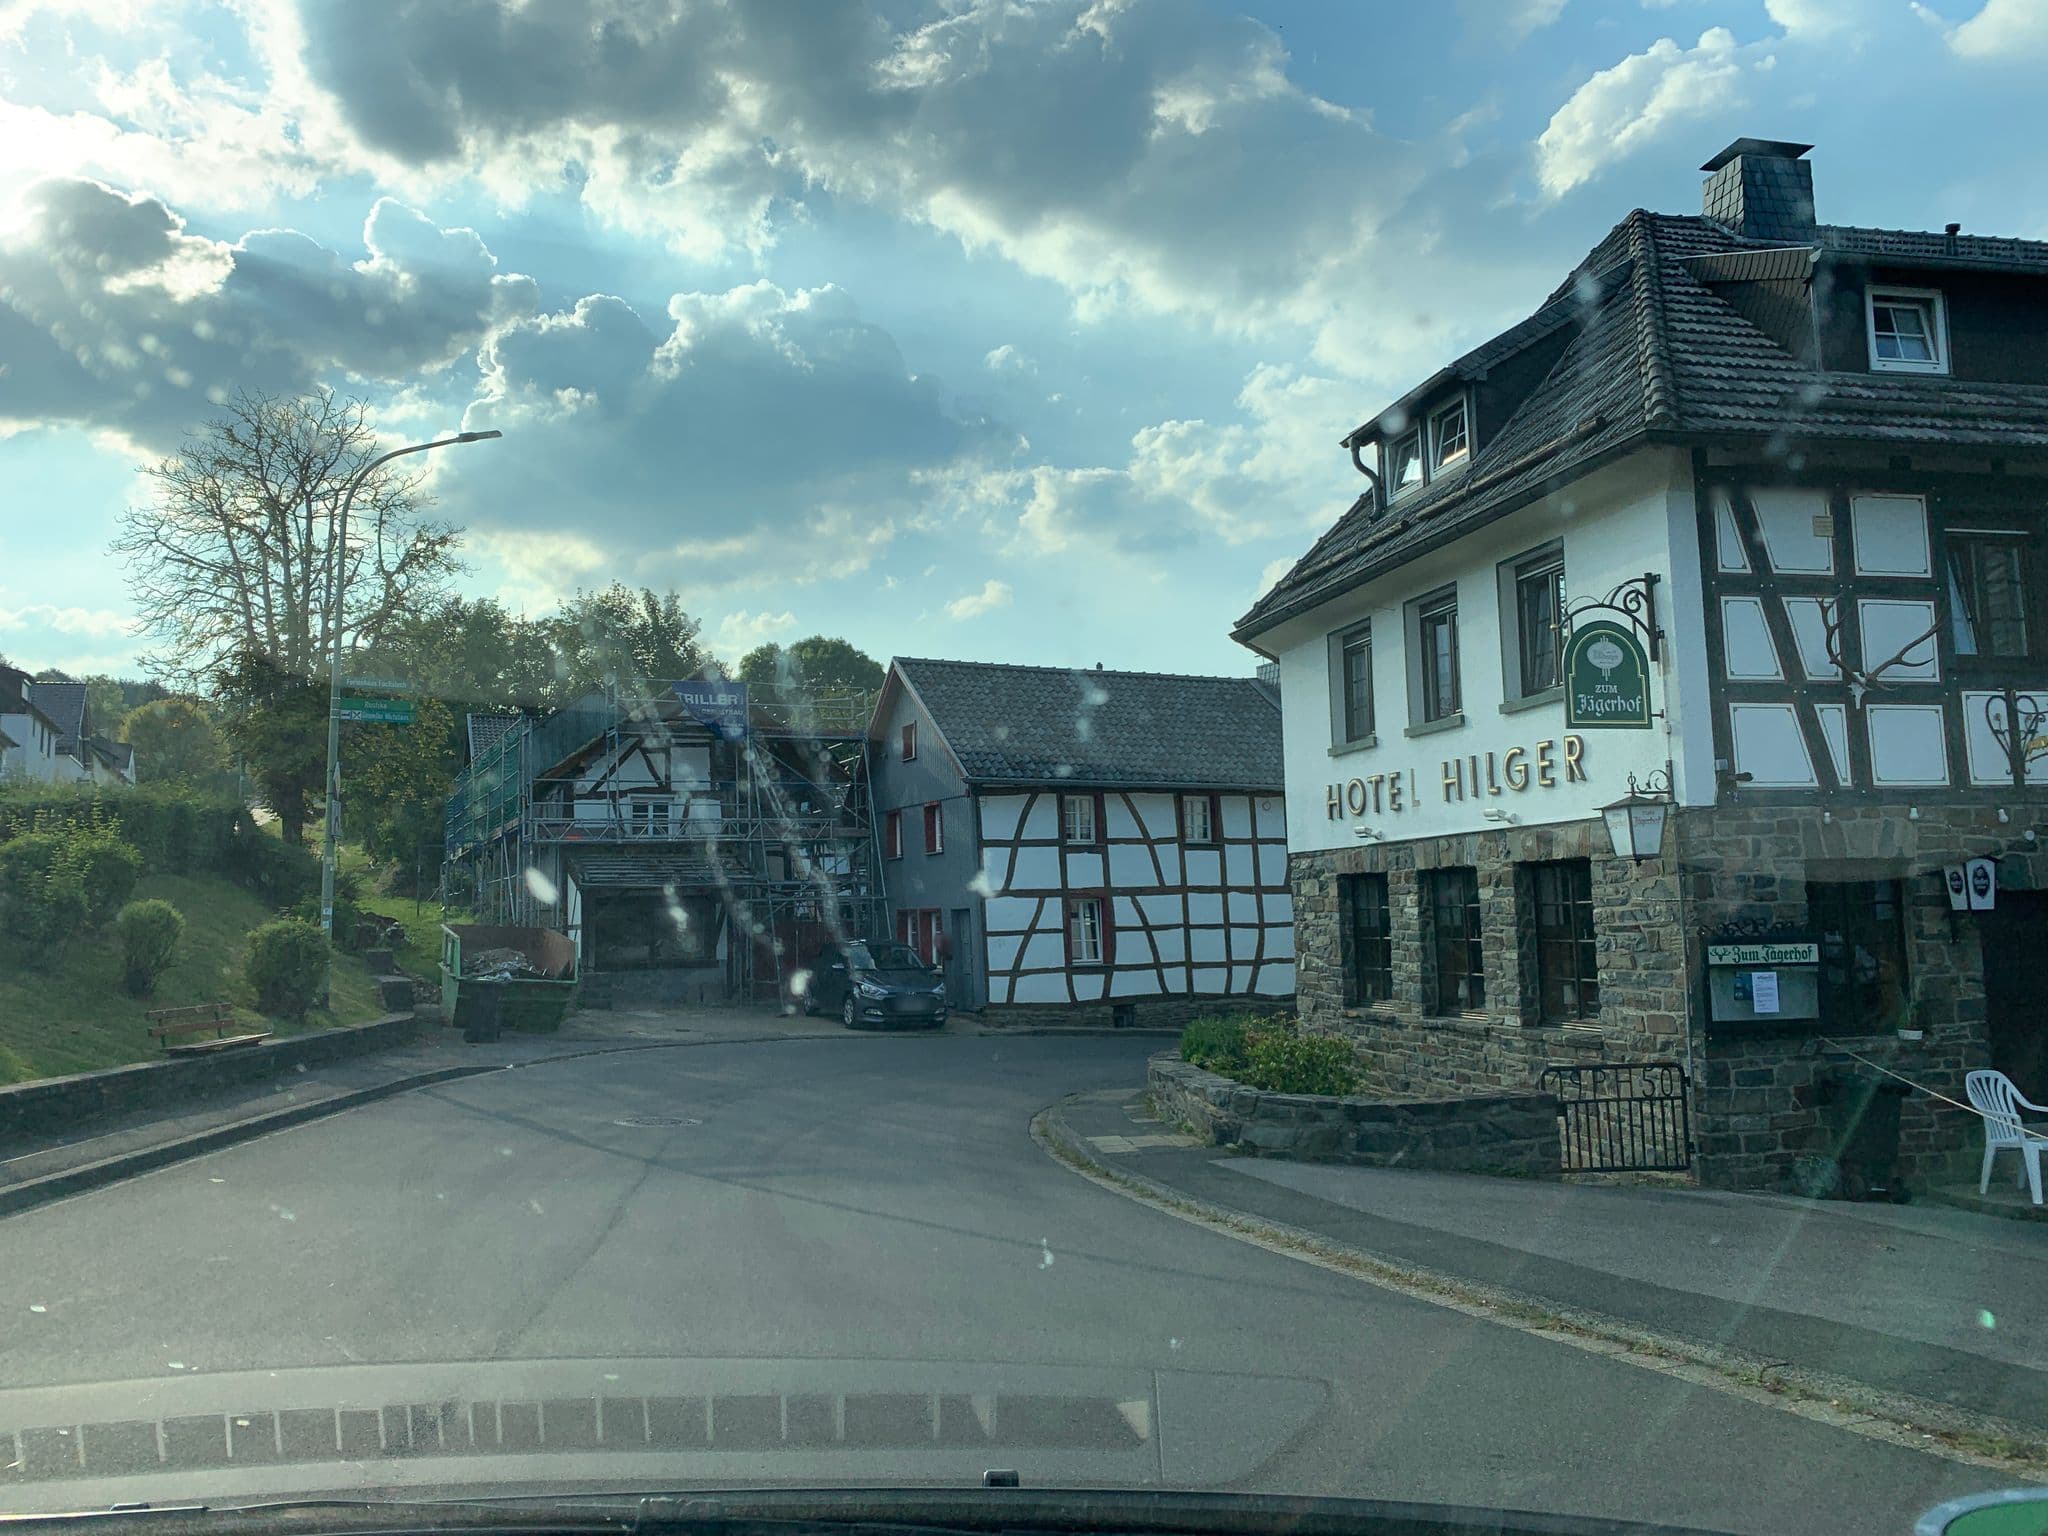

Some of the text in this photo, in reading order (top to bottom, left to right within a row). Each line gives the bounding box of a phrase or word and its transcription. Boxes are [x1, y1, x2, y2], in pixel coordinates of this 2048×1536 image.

[1595, 684, 1618, 694] ZUM
[1576, 694, 1642, 716] Jägerhof
[1325, 734, 1587, 820] HOTEL HILGER
[1732, 945, 1812, 963] Zum Jägerhof
